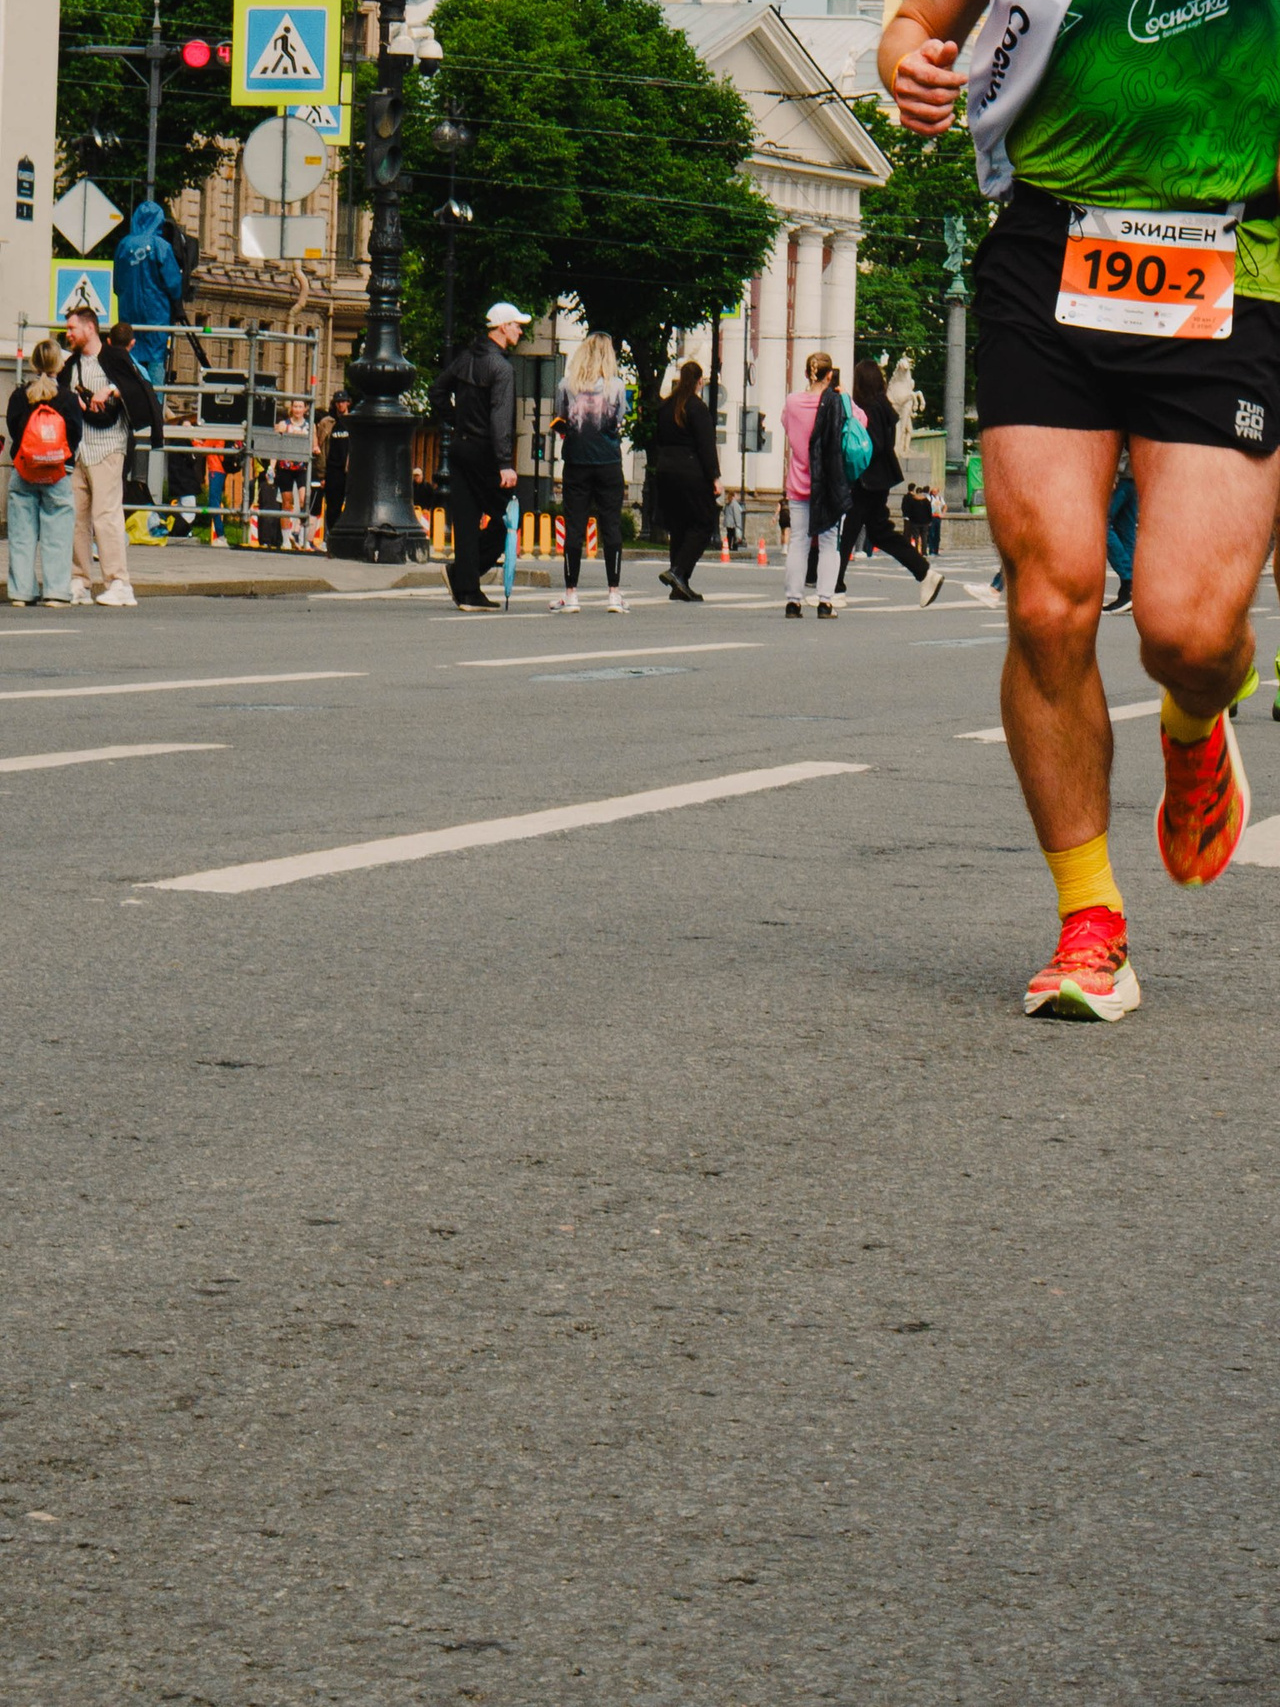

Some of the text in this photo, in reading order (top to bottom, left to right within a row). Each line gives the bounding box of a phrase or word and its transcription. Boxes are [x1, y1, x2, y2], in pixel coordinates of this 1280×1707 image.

[1121, 220, 1217, 243] ЭКИДЕН
[1083, 249, 1206, 300] 190-2
[1235, 410, 1264, 431] GO
